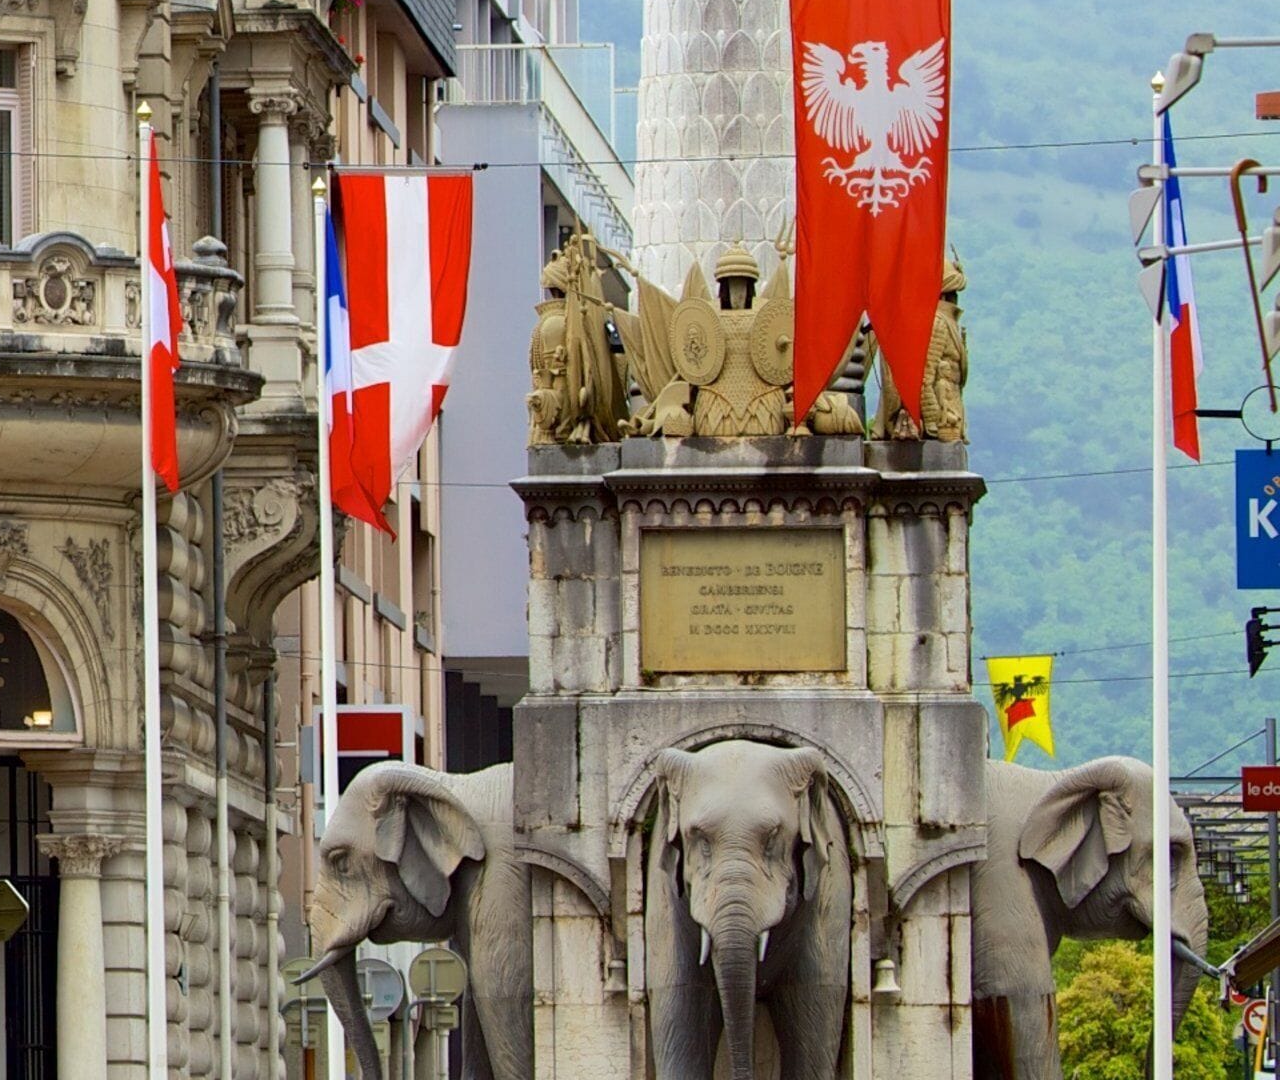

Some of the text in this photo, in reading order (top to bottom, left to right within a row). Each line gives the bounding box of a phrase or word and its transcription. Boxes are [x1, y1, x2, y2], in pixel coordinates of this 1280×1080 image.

[661, 565, 733, 577] BENEDICTO
[765, 562, 824, 576] BOIGNE
[690, 604, 794, 616] GRATA CIVITAS
